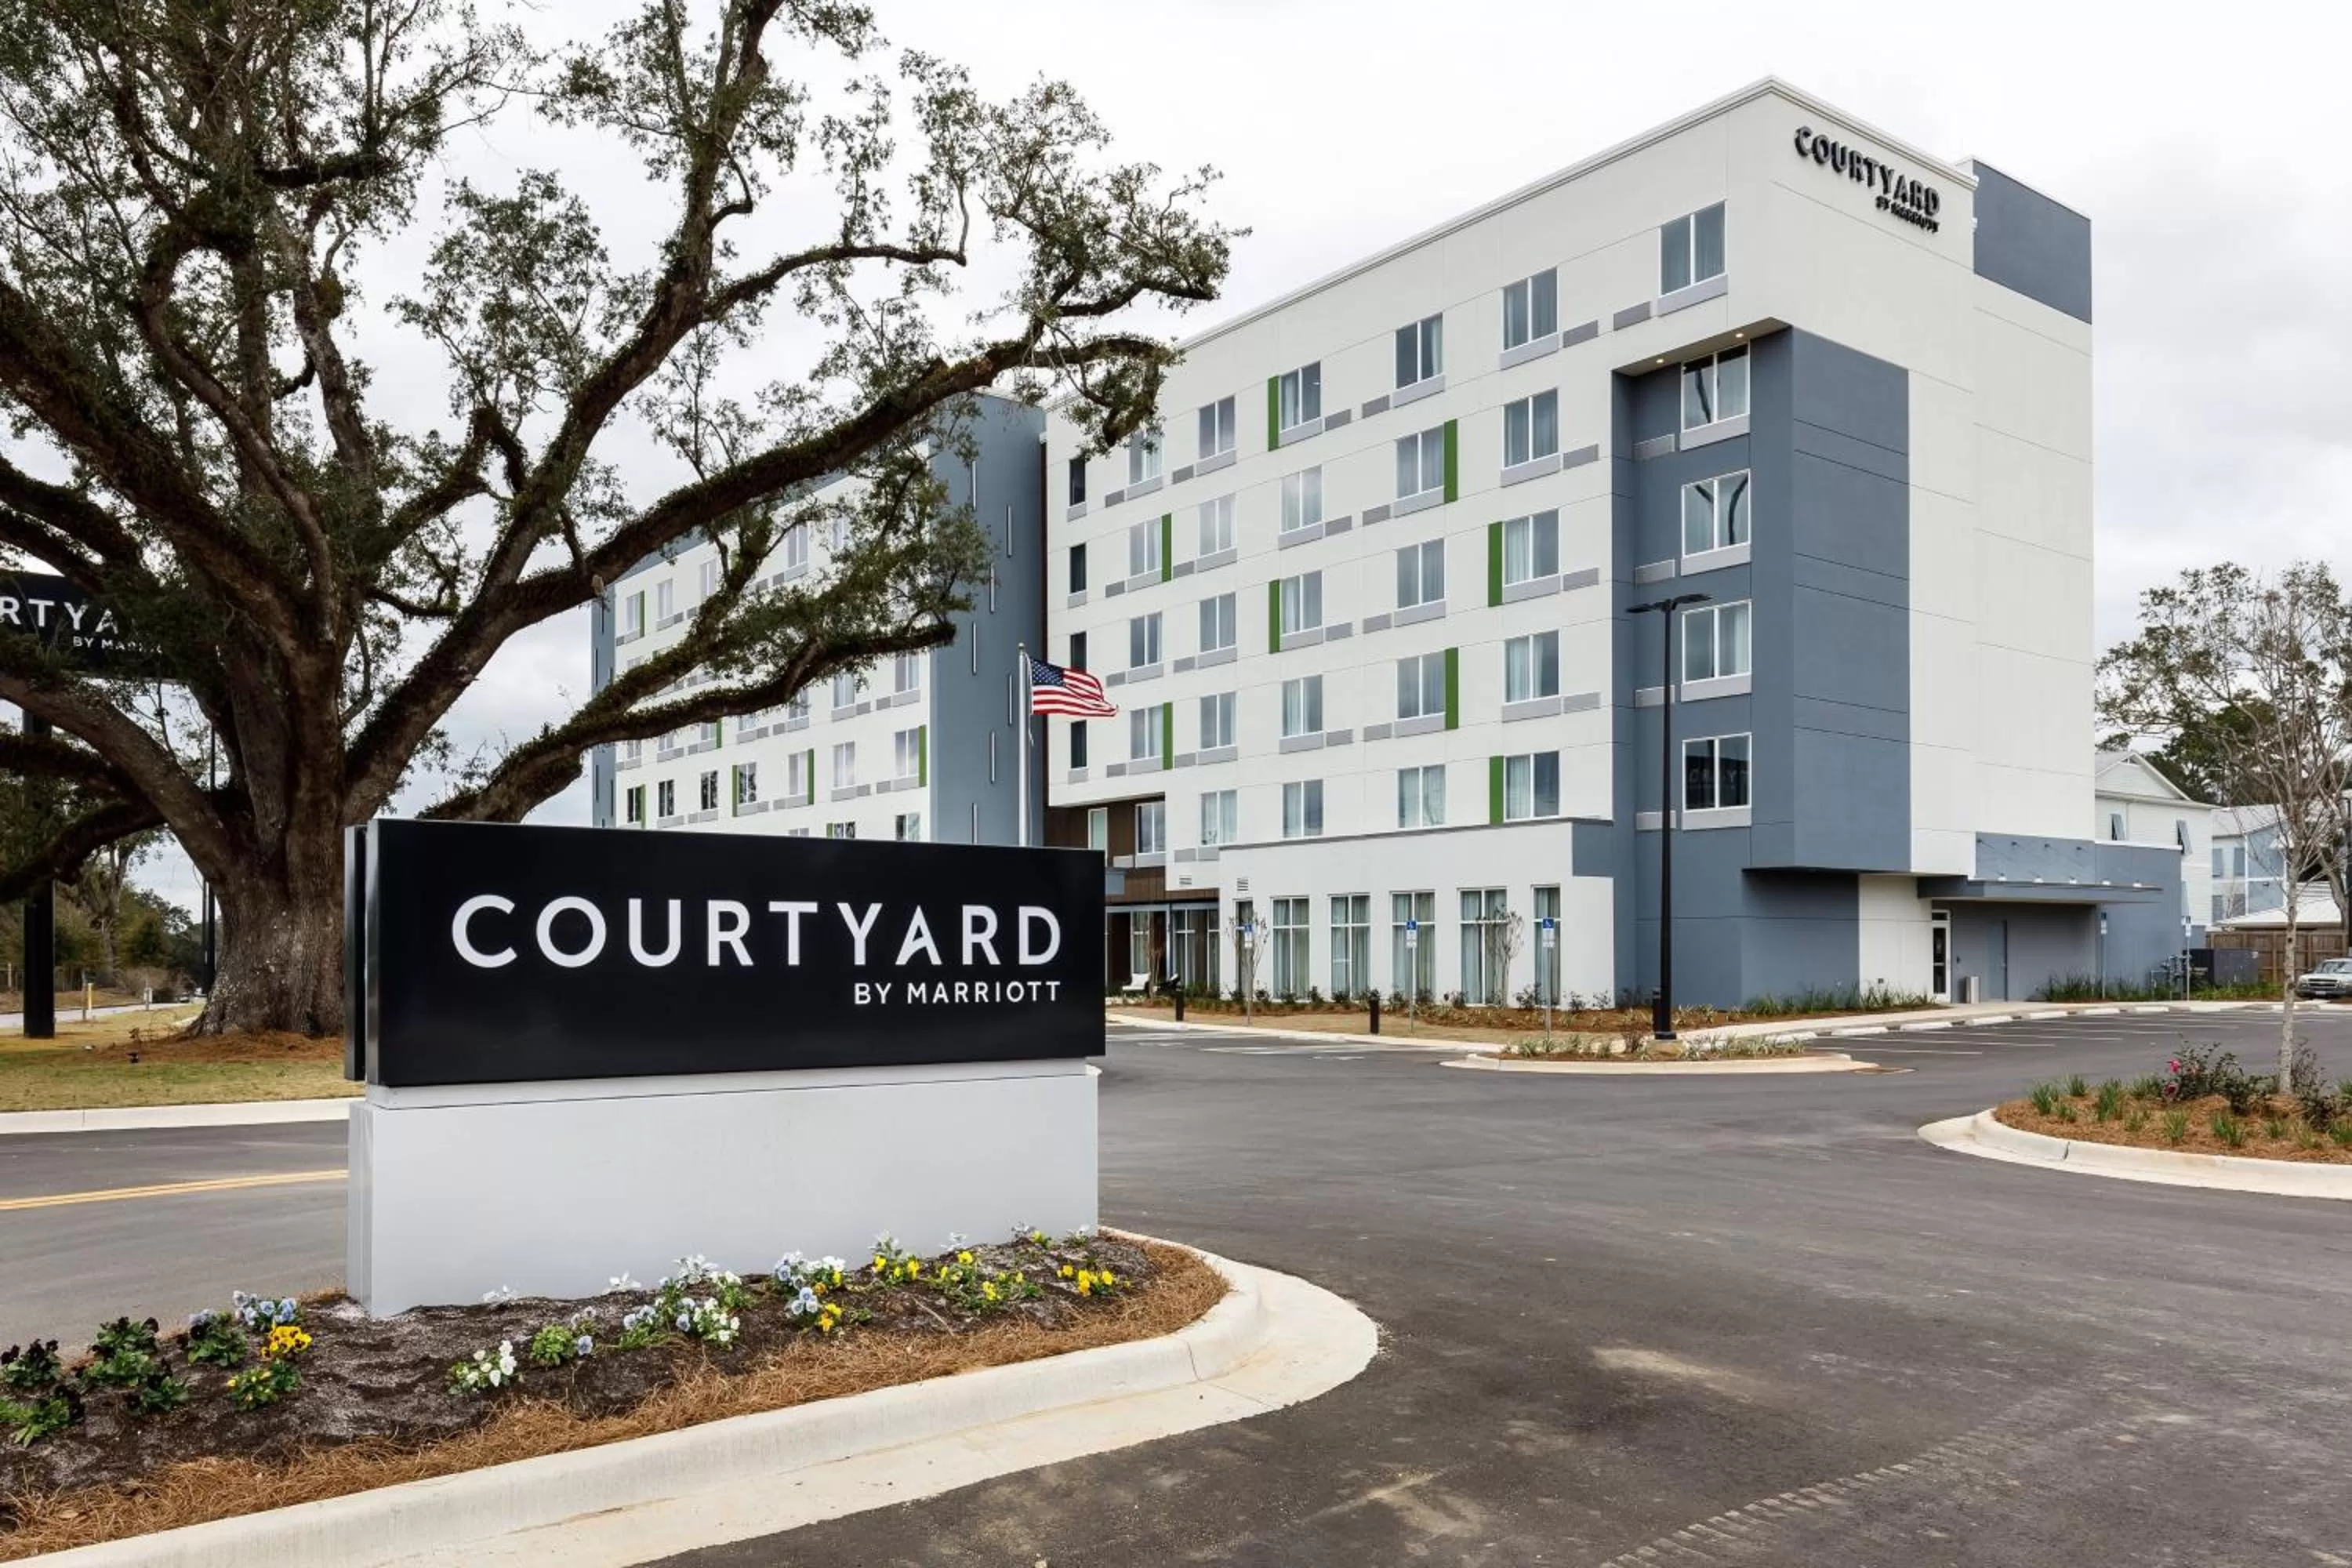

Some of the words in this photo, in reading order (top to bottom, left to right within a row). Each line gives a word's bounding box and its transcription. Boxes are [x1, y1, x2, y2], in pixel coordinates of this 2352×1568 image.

[1794, 125, 1940, 216] COURTYARD
[74, 636, 93, 648] BY
[452, 895, 1061, 968] COURTYARD
[855, 982, 891, 1004] BY
[907, 981, 1061, 1004] MARRIOTT
